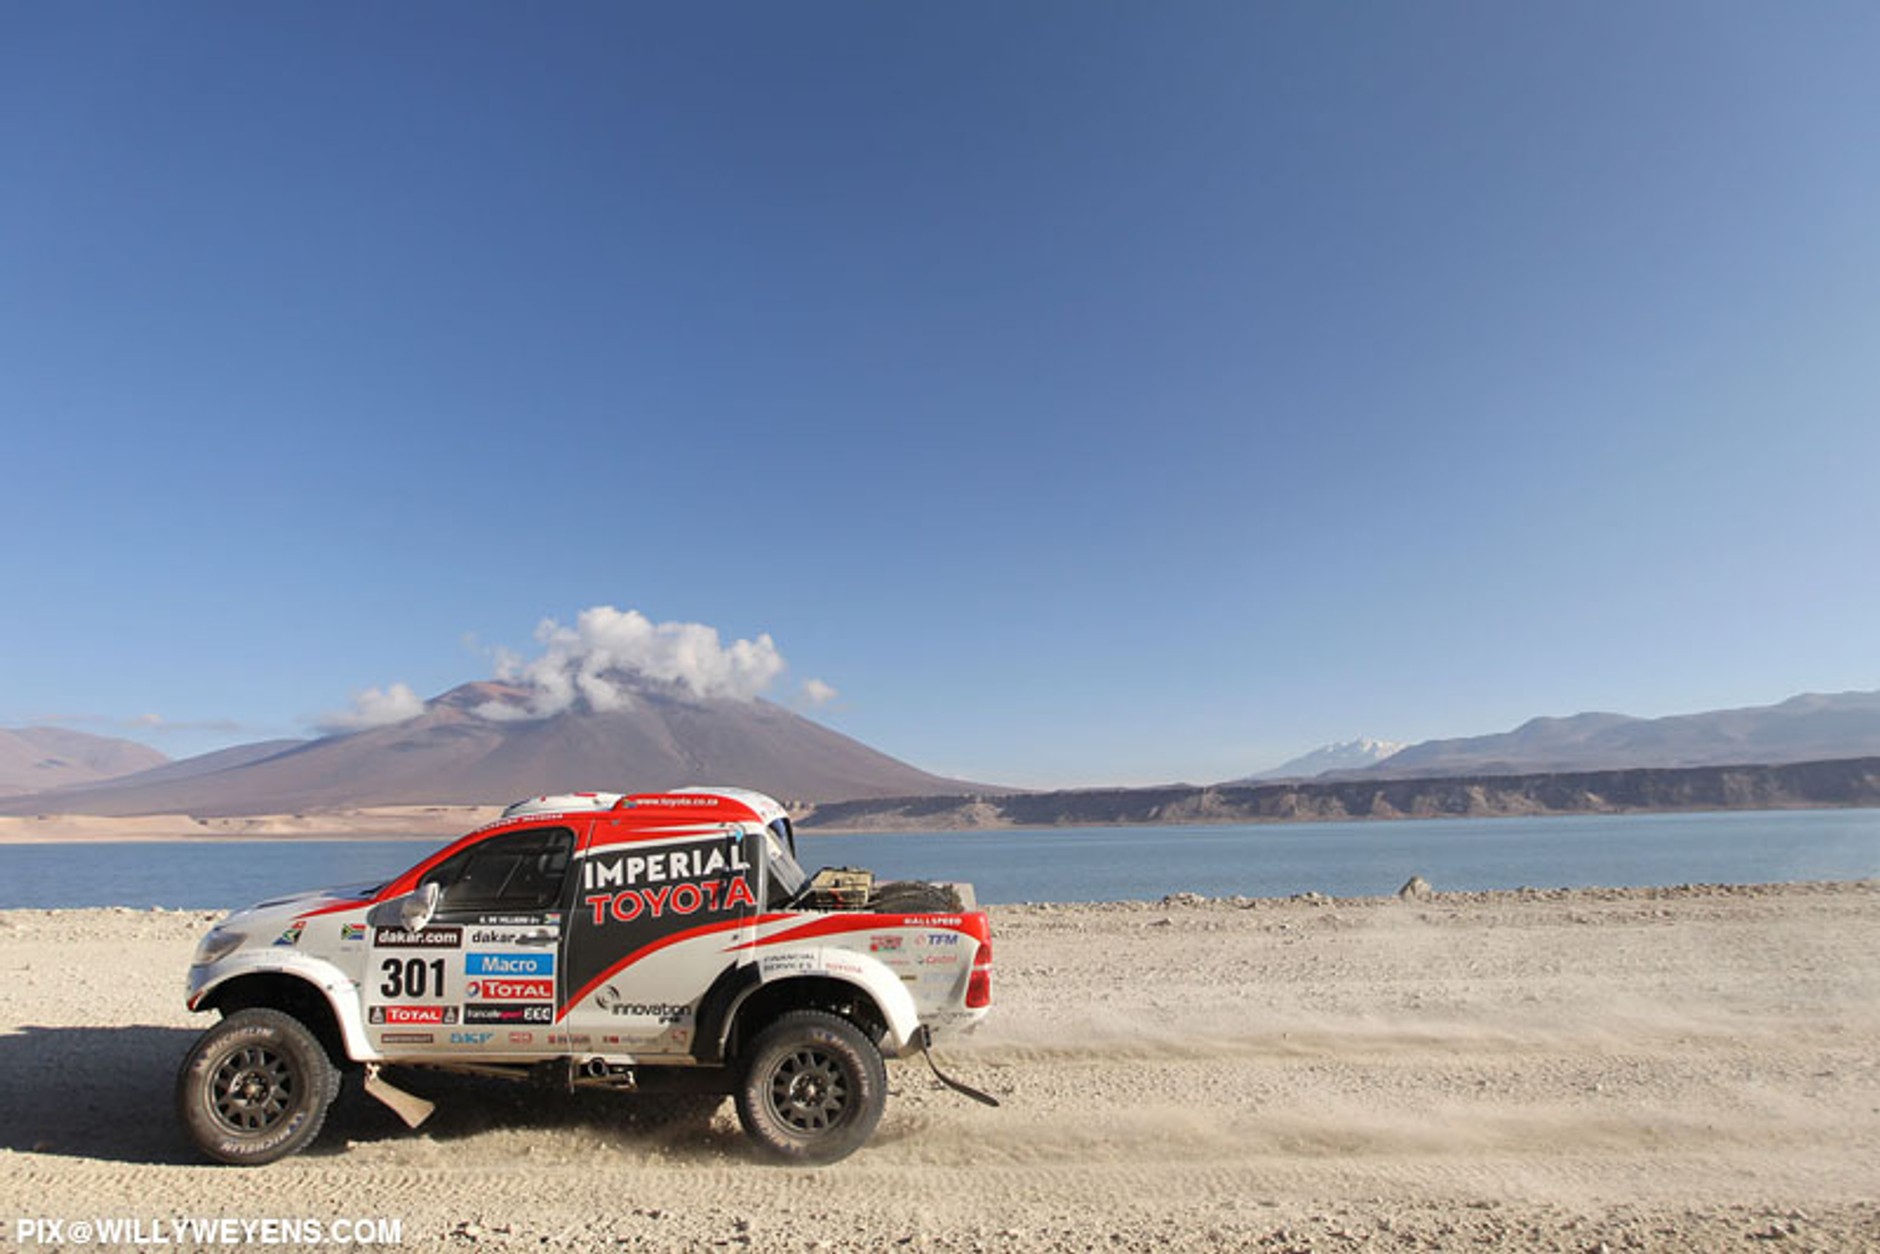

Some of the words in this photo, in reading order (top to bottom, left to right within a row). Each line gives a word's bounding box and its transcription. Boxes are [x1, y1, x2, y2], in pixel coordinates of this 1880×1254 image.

[585, 845, 750, 889] IMPERIAL
[585, 875, 757, 925] TOYOTA
[378, 930, 458, 944] dakar.com
[928, 934, 958, 945] TFM
[481, 956, 538, 973] Macro
[380, 957, 445, 998] 301
[486, 981, 551, 997] TOTAL
[391, 1008, 440, 1021] TOTAL
[612, 1002, 692, 1016] innovation
